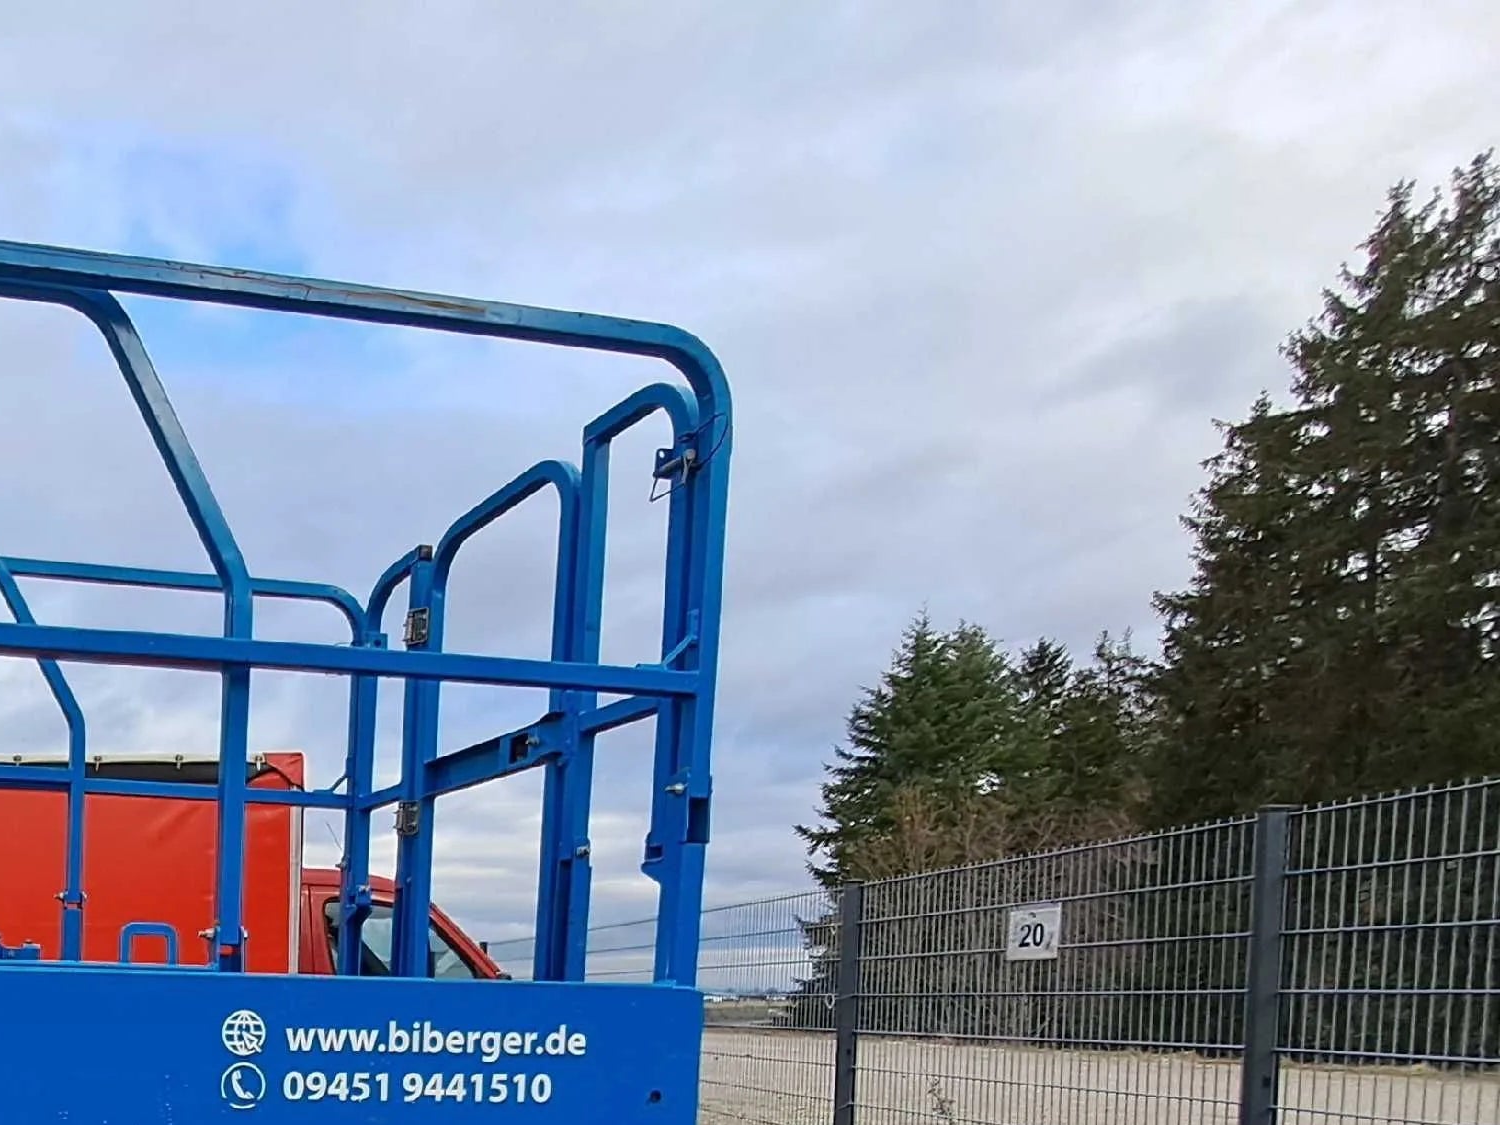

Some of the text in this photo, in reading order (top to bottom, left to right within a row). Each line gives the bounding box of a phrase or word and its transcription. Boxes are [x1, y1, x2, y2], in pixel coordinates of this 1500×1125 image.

[1018, 922, 1045, 947] 20
[285, 1021, 587, 1063] www.biberger.de
[283, 1071, 552, 1103] 09451 9441510
